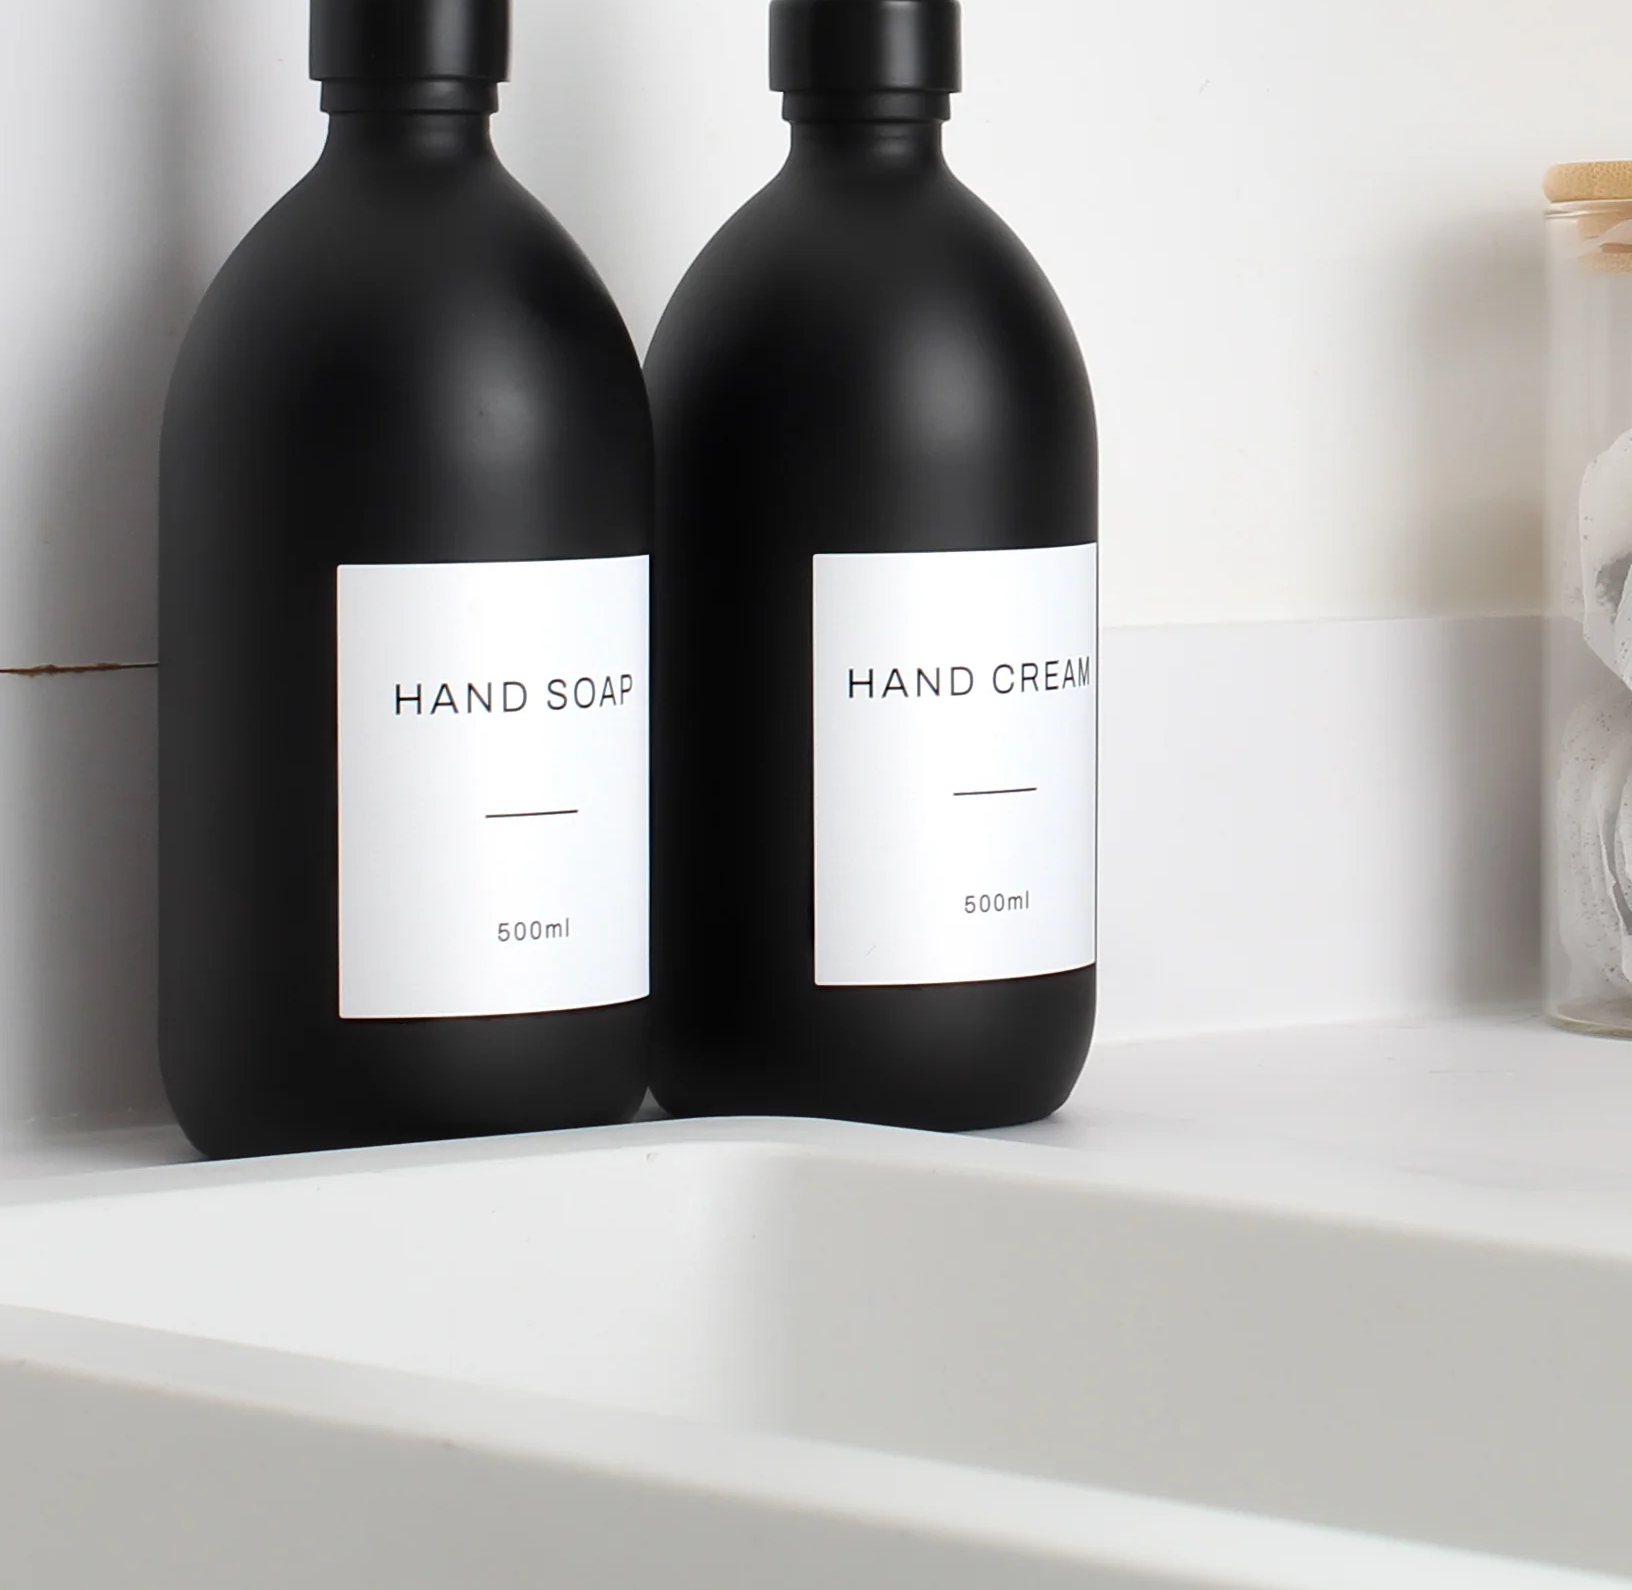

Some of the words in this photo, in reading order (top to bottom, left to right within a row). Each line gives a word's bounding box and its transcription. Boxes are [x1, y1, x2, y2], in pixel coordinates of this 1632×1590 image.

[848, 665, 974, 699] HAND
[991, 655, 1090, 695] CREAM
[394, 680, 528, 716] HAND
[546, 673, 633, 711] SOAP
[963, 890, 1030, 914] 500ml
[497, 917, 570, 943] 500ml
